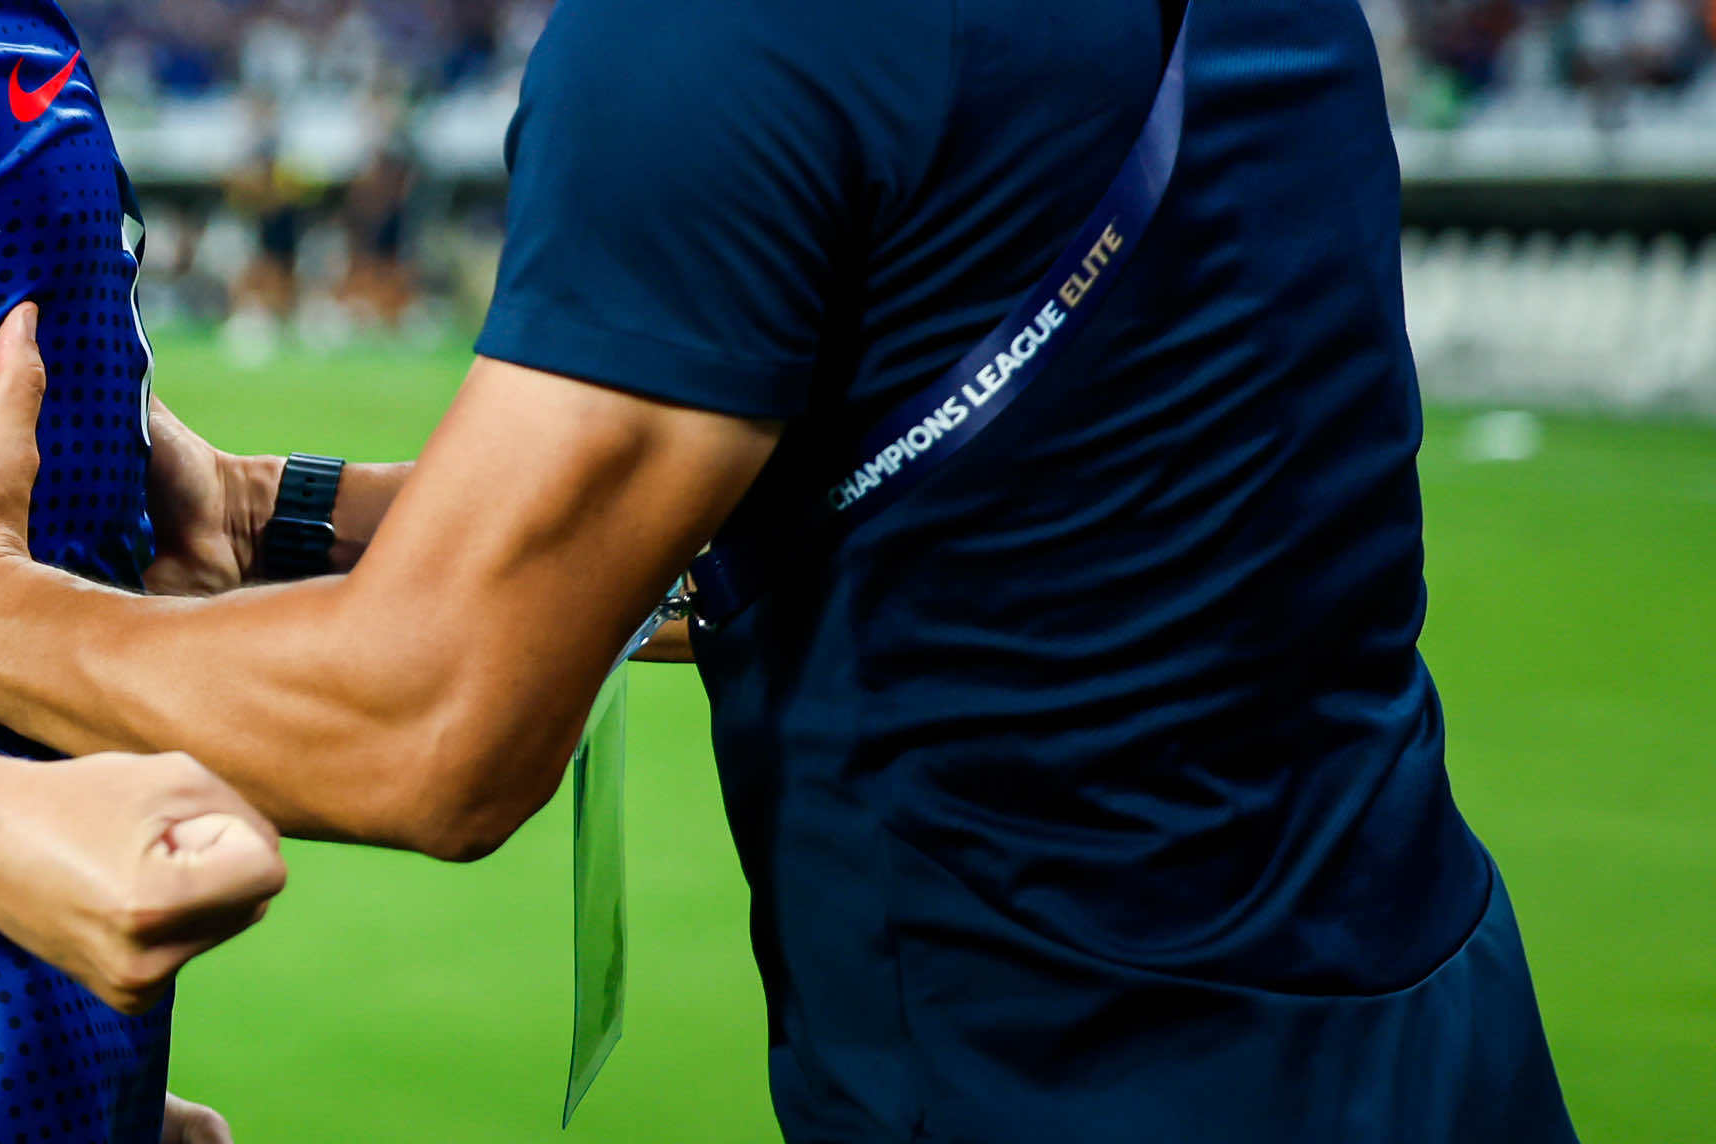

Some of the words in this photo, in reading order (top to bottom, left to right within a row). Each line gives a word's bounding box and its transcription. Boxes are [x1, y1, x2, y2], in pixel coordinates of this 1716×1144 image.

[828, 396, 968, 510] CHAMPIONS
[961, 299, 1066, 406] LEAGUE
[1059, 222, 1123, 307] ELITE
